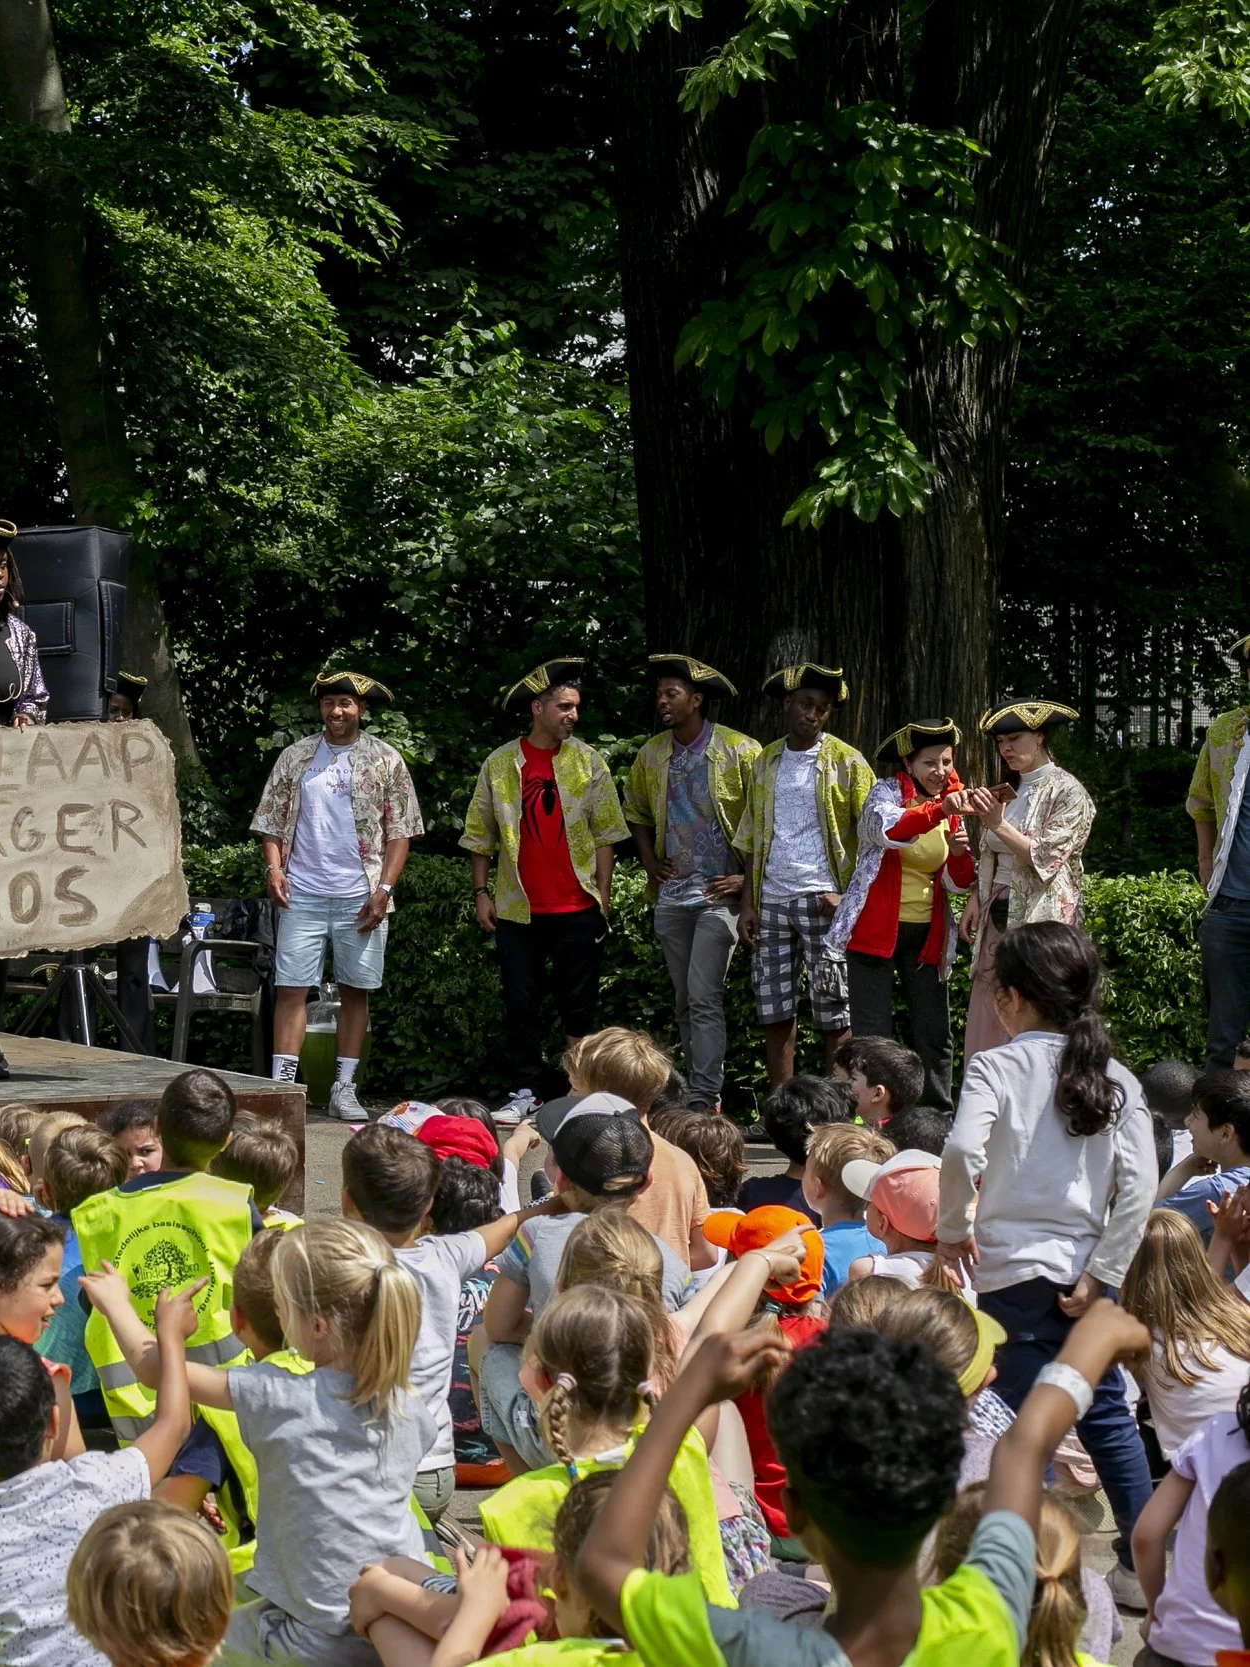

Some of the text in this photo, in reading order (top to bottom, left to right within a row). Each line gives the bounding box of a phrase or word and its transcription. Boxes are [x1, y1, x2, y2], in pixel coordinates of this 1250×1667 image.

[113, 1220, 210, 1269] Stedelijke basisschool
[196, 1261, 217, 1315] rgerhout
